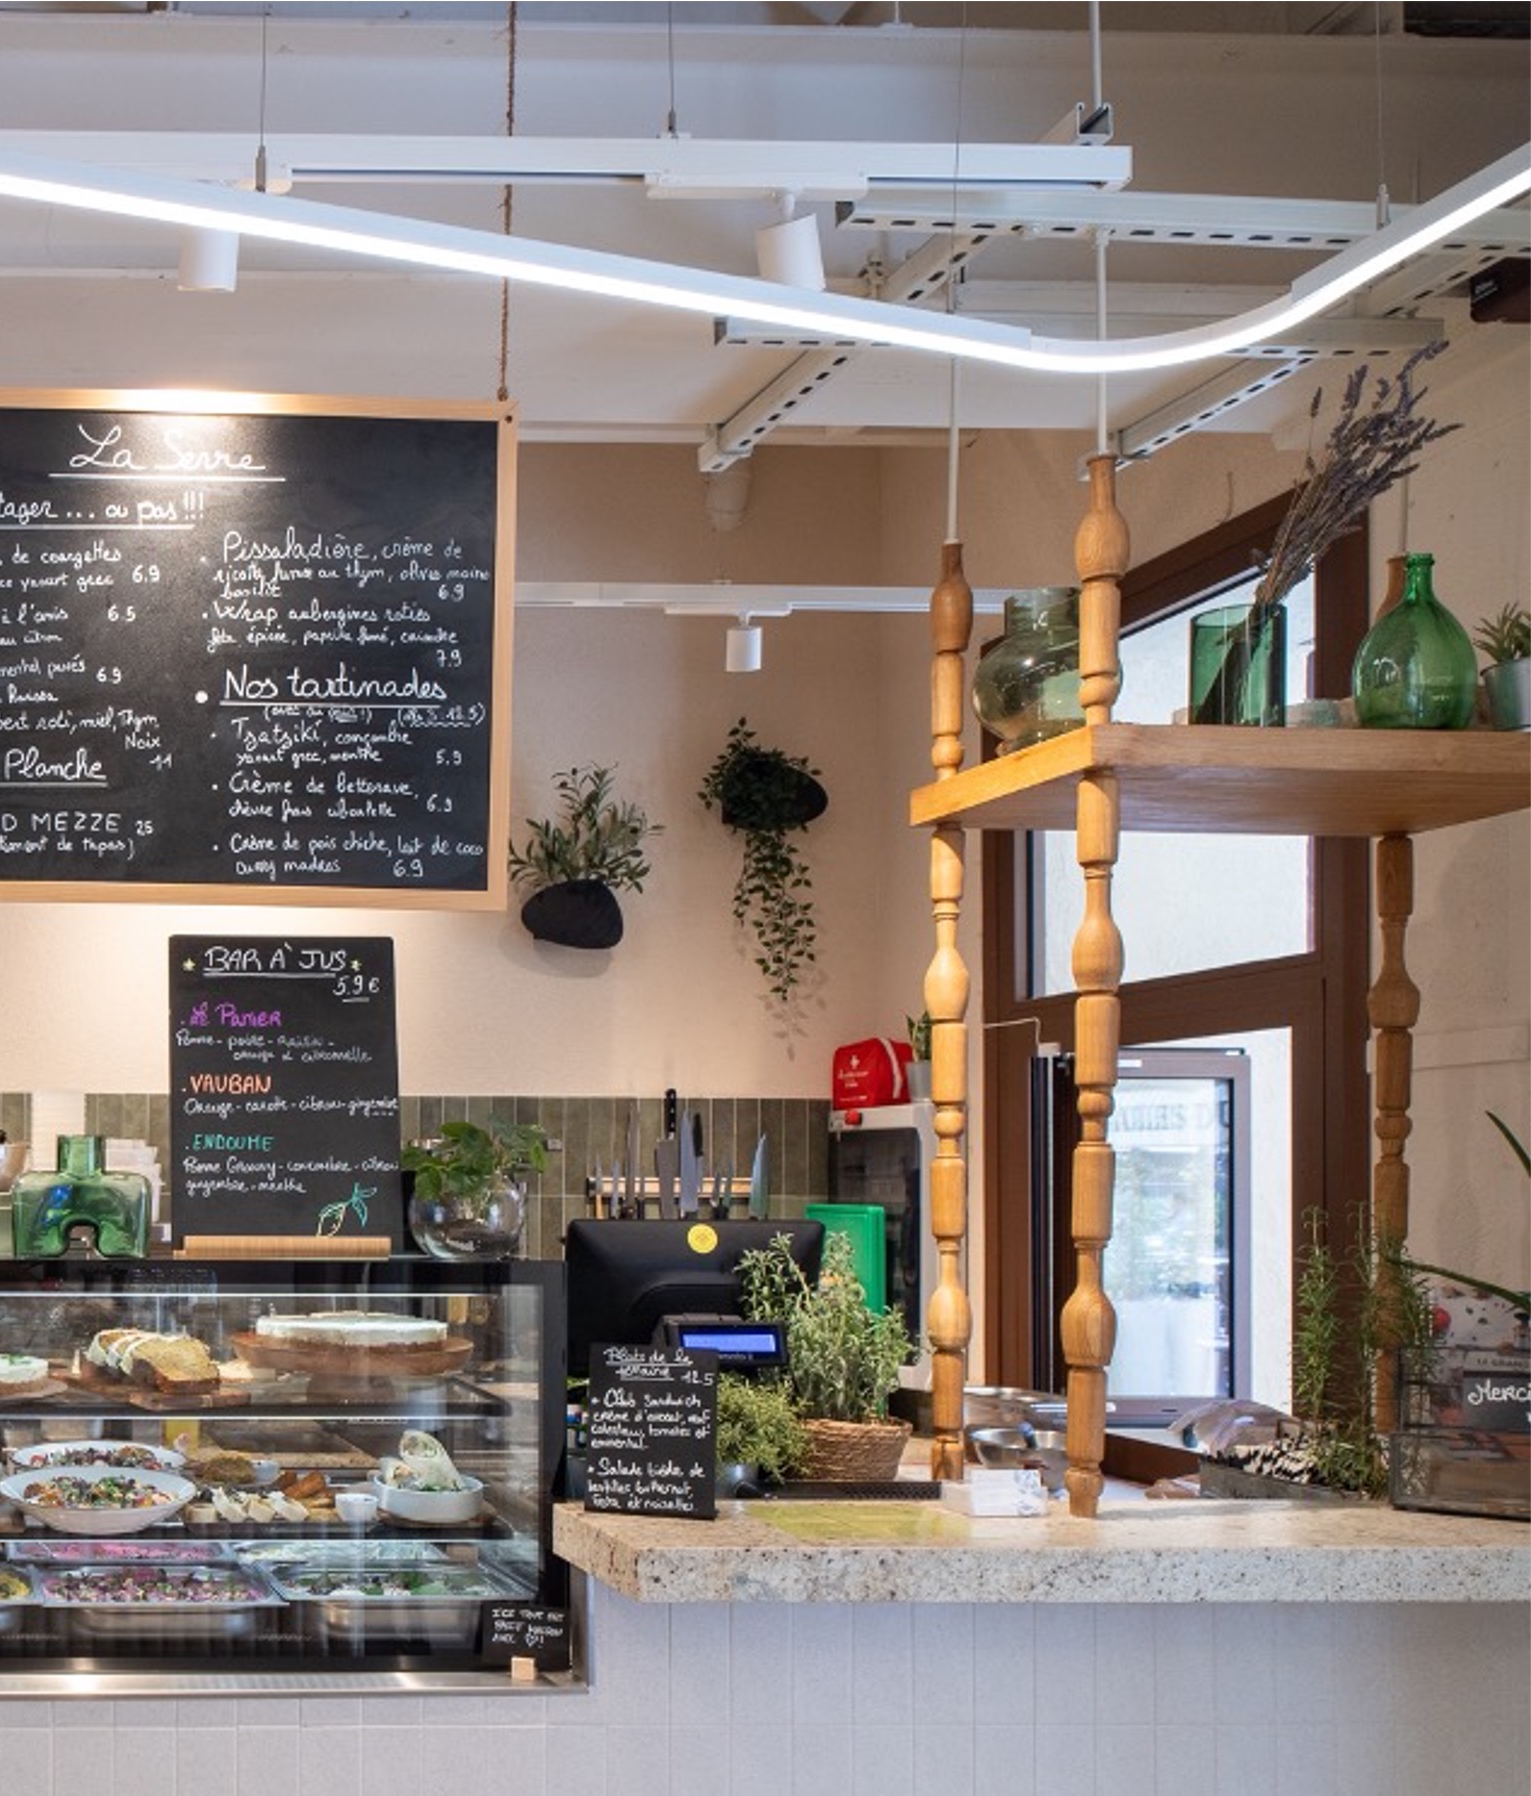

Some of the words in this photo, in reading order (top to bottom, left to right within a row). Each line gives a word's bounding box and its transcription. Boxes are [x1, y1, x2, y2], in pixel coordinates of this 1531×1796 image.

[70, 424, 146, 469] La
[153, 427, 266, 471] Serre
[12, 543, 30, 565] de
[40, 540, 121, 570] courgettes
[444, 538, 462, 559] de
[76, 574, 114, 593] grec
[132, 565, 160, 584] 6.9
[438, 583, 465, 602] 6.9
[2, 608, 12, 625] à
[108, 605, 137, 623] 6.5
[213, 599, 279, 627] Wrap
[288, 598, 379, 628] aubergines
[0, 636, 18, 647] au
[303, 629, 352, 646] paprika
[436, 649, 462, 668] 7.9
[96, 665, 122, 684] 6.9
[224, 663, 279, 701] Nos
[287, 661, 448, 700] tartinades
[124, 731, 162, 750] Noix
[3, 745, 107, 780] Planche
[436, 749, 463, 767] 5.9
[228, 770, 293, 795] Crème
[306, 776, 325, 795] de
[327, 799, 397, 819] ciboulette
[426, 794, 453, 814] 6.9
[31, 811, 121, 833] MEZZE
[134, 819, 154, 837] 25
[57, 835, 74, 852] de
[282, 832, 301, 851] de
[308, 836, 338, 856] pois
[397, 836, 423, 855] lait
[431, 834, 451, 855] de
[284, 857, 341, 873] madras
[393, 858, 424, 879] 6.9
[203, 945, 263, 972] BAR
[298, 949, 348, 972] JUS
[189, 1072, 273, 1094] VAUBAN
[184, 1097, 234, 1121] Orange
[193, 1133, 275, 1151] ENDOUME
